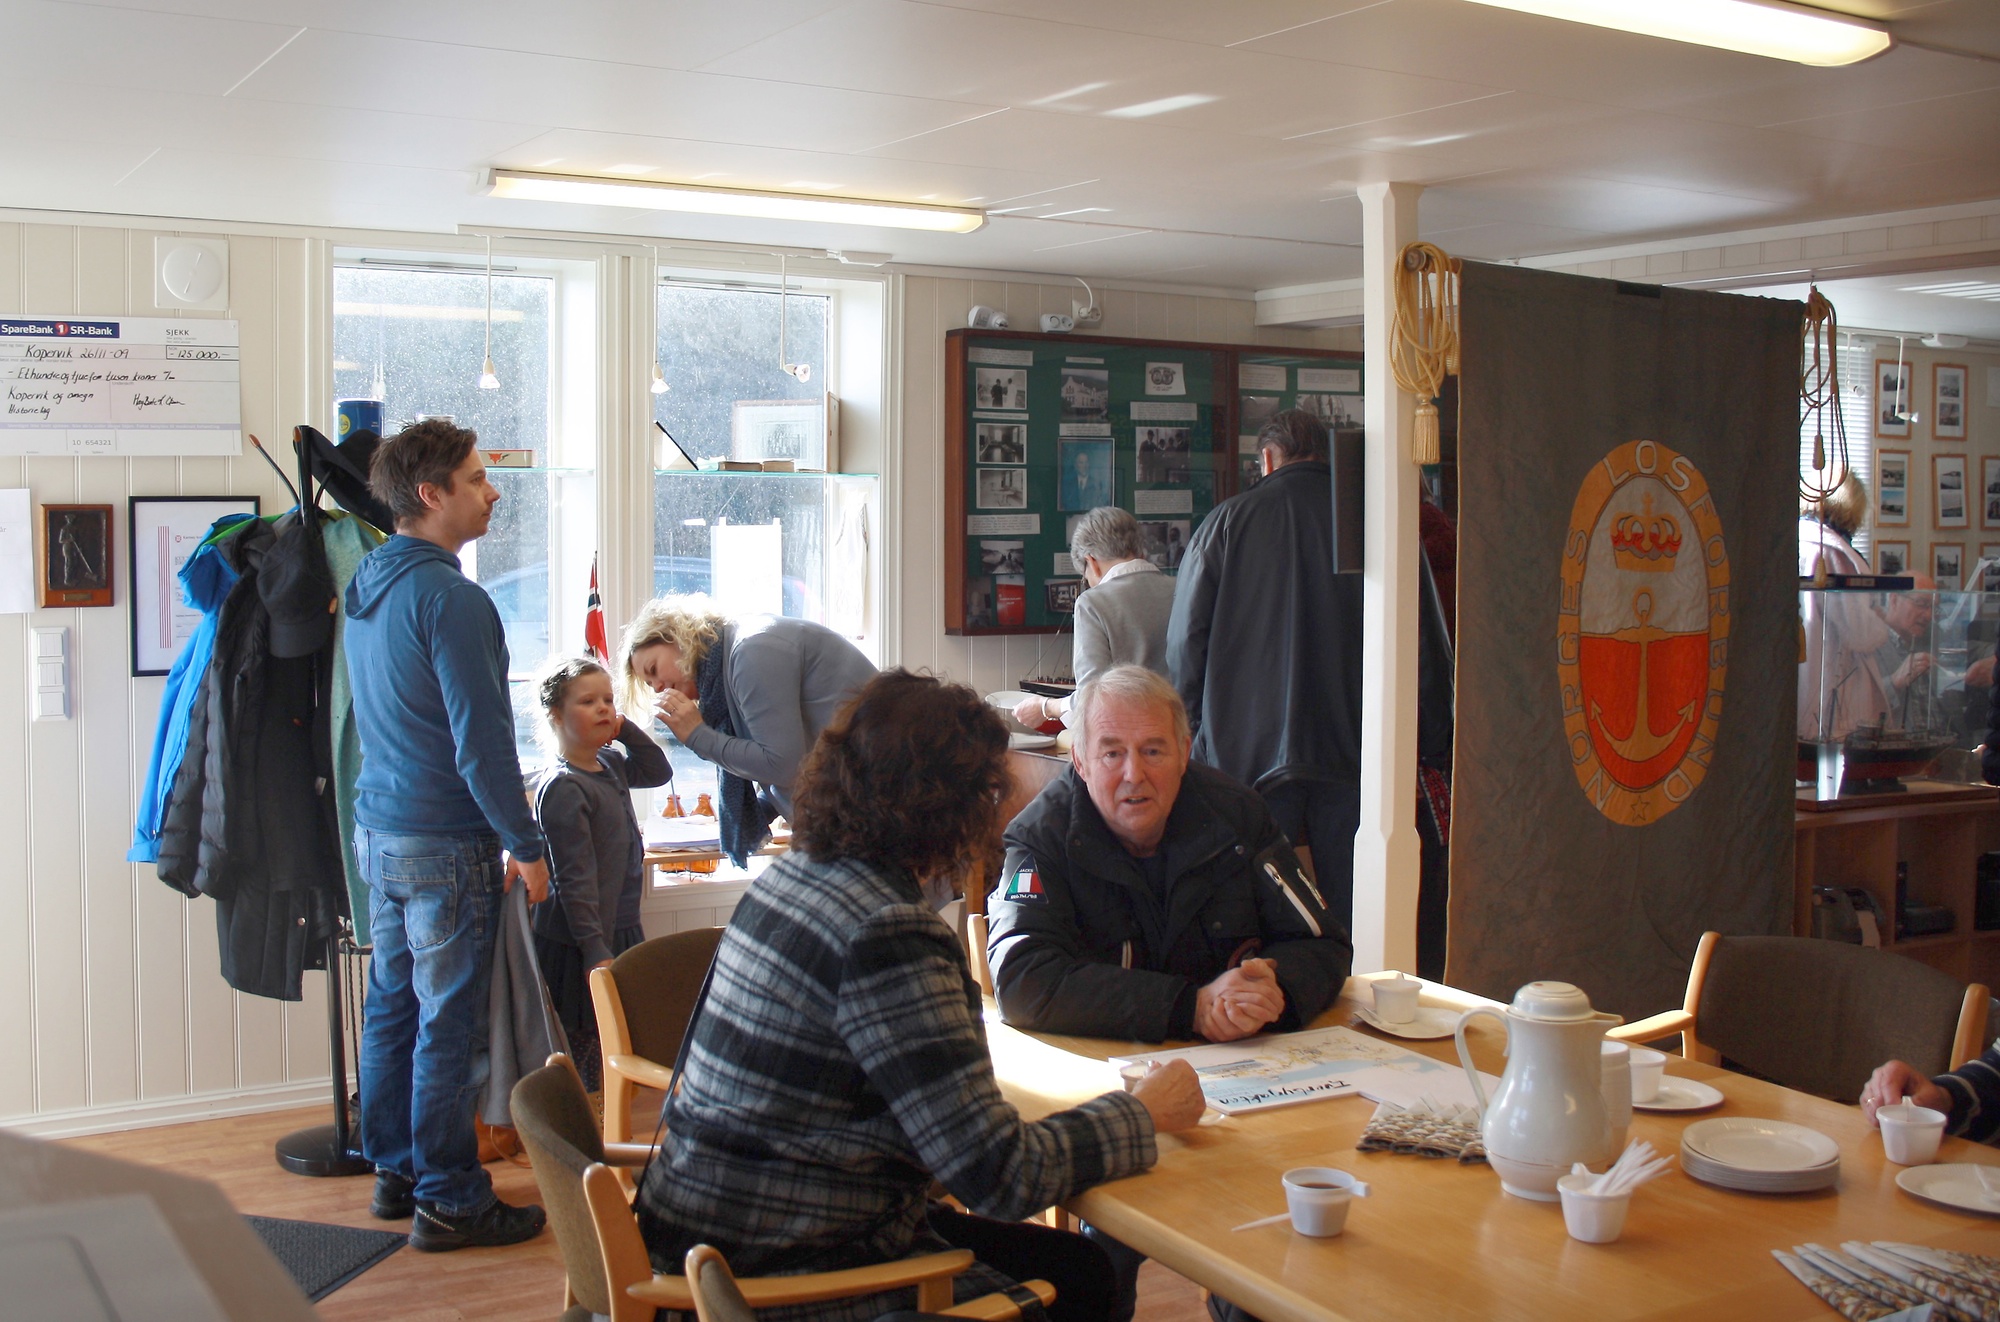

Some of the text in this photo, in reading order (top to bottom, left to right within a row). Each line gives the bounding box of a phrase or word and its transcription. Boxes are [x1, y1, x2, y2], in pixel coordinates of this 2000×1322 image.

[1, 324, 113, 336] SpareBank 1 SR-Bank
[25, 344, 73, 361] Kopervik
[8, 385, 48, 401] Kopervik
[53, 392, 64, 405] og
